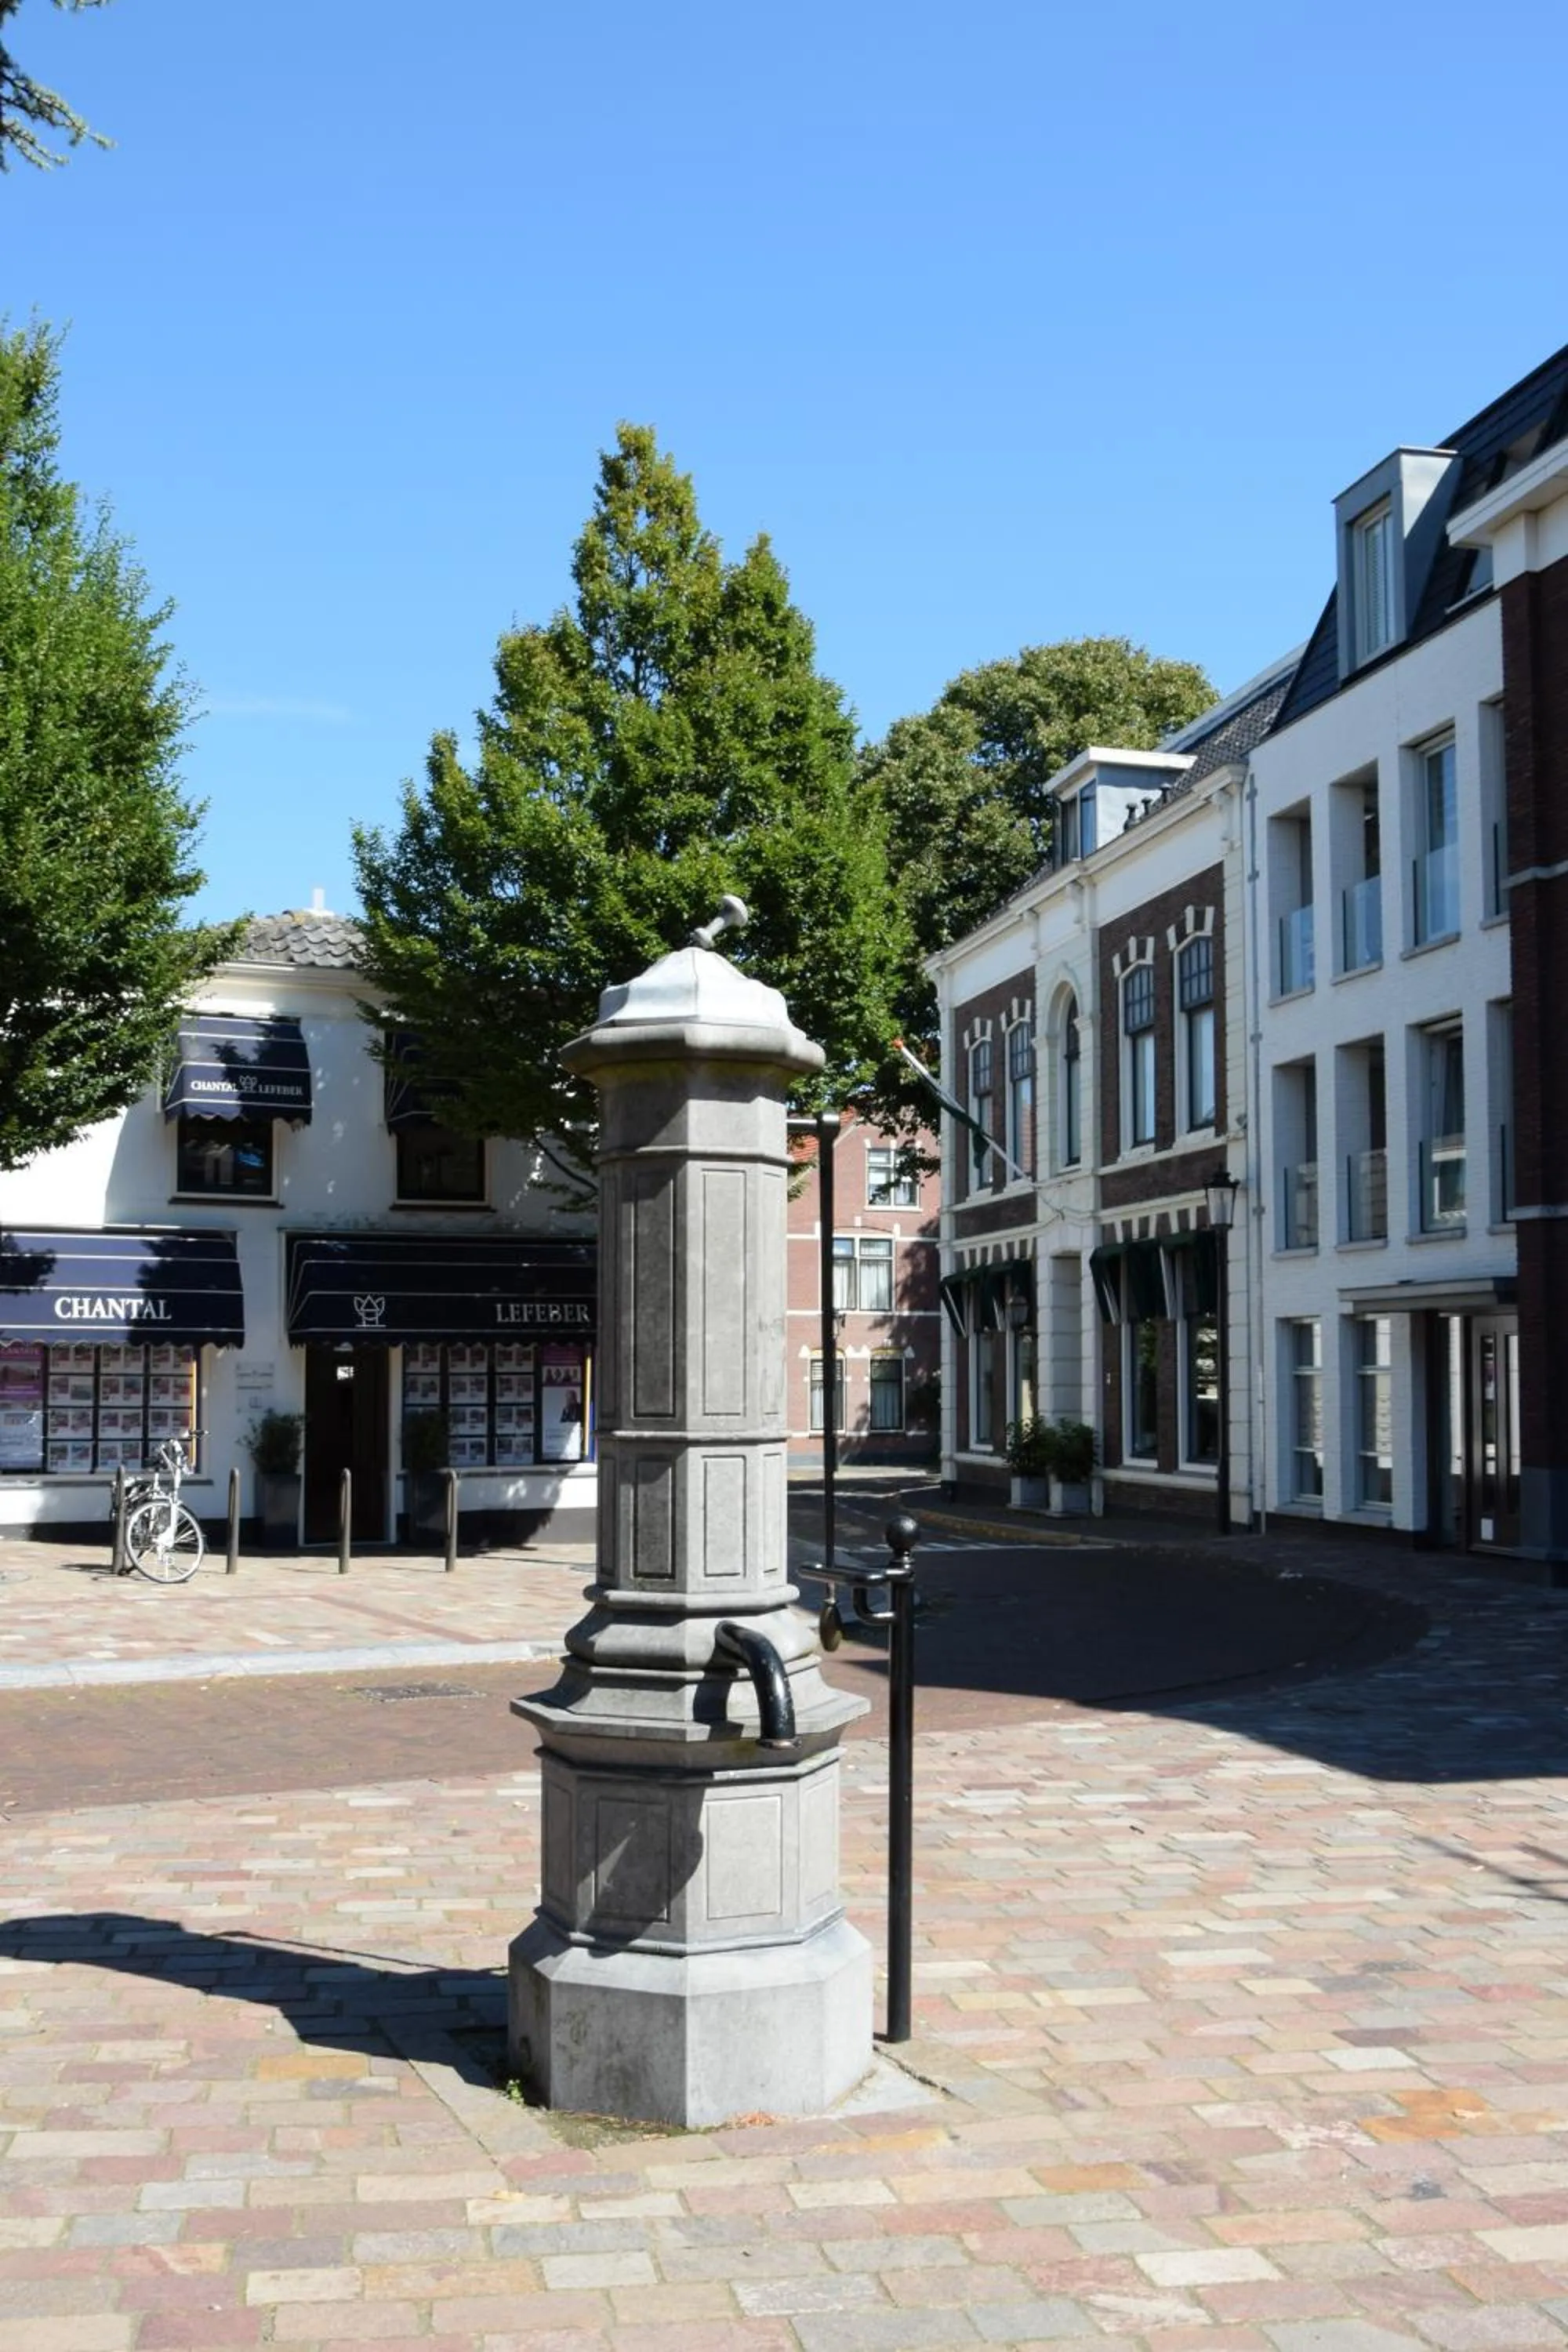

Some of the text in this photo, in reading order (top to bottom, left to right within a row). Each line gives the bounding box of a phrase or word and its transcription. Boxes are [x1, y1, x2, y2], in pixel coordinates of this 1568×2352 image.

[191, 1080, 238, 1092] CHANTAL
[54, 1297, 172, 1319] CHANTAL
[496, 1304, 590, 1323] LEFEBER
